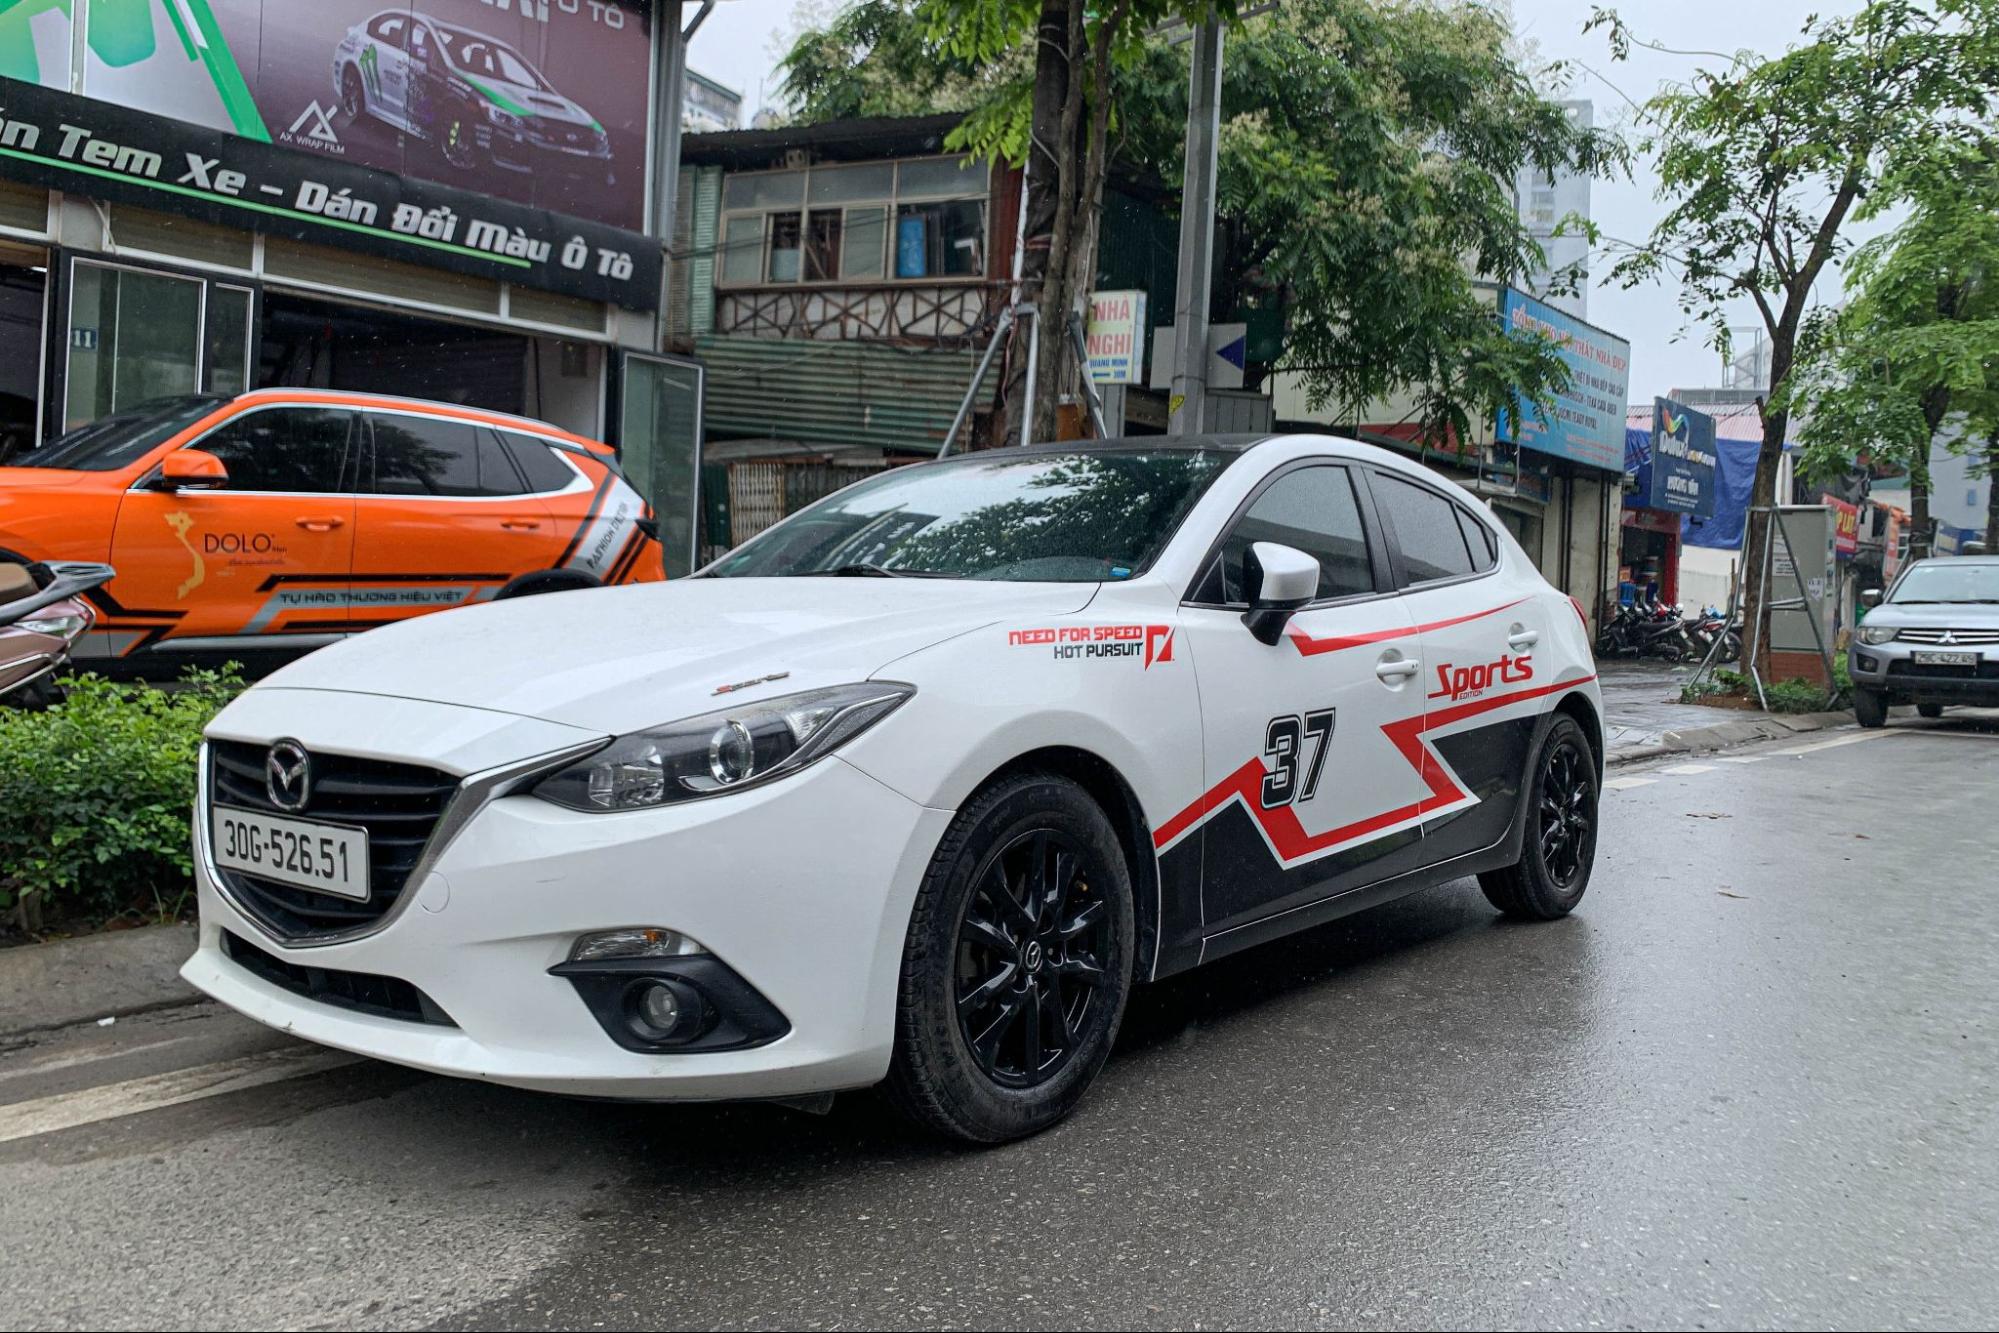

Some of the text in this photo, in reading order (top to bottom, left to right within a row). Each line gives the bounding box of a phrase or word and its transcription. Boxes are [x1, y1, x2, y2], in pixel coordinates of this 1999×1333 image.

[587, 1, 624, 30] TÔ
[280, 131, 345, 155] AX WRAP FILM
[58, 123, 162, 178] Tem
[178, 153, 247, 195] Xe
[295, 180, 378, 226] Dán
[391, 203, 458, 242] Đổi
[465, 218, 552, 264] Màu
[560, 234, 588, 270] Ô
[597, 248, 634, 281] Tô
[1087, 295, 1131, 355] NHÀ NGHỈ
[204, 533, 271, 553] DOLO
[1009, 626, 1143, 645] NEED FOR SPEED
[1054, 642, 1143, 659] HOT PURSUIT
[1428, 655, 1533, 701] Sports
[1459, 690, 1483, 700] EDITION
[1261, 706, 1336, 811] 37
[224, 819, 348, 883] 30G-526.51
